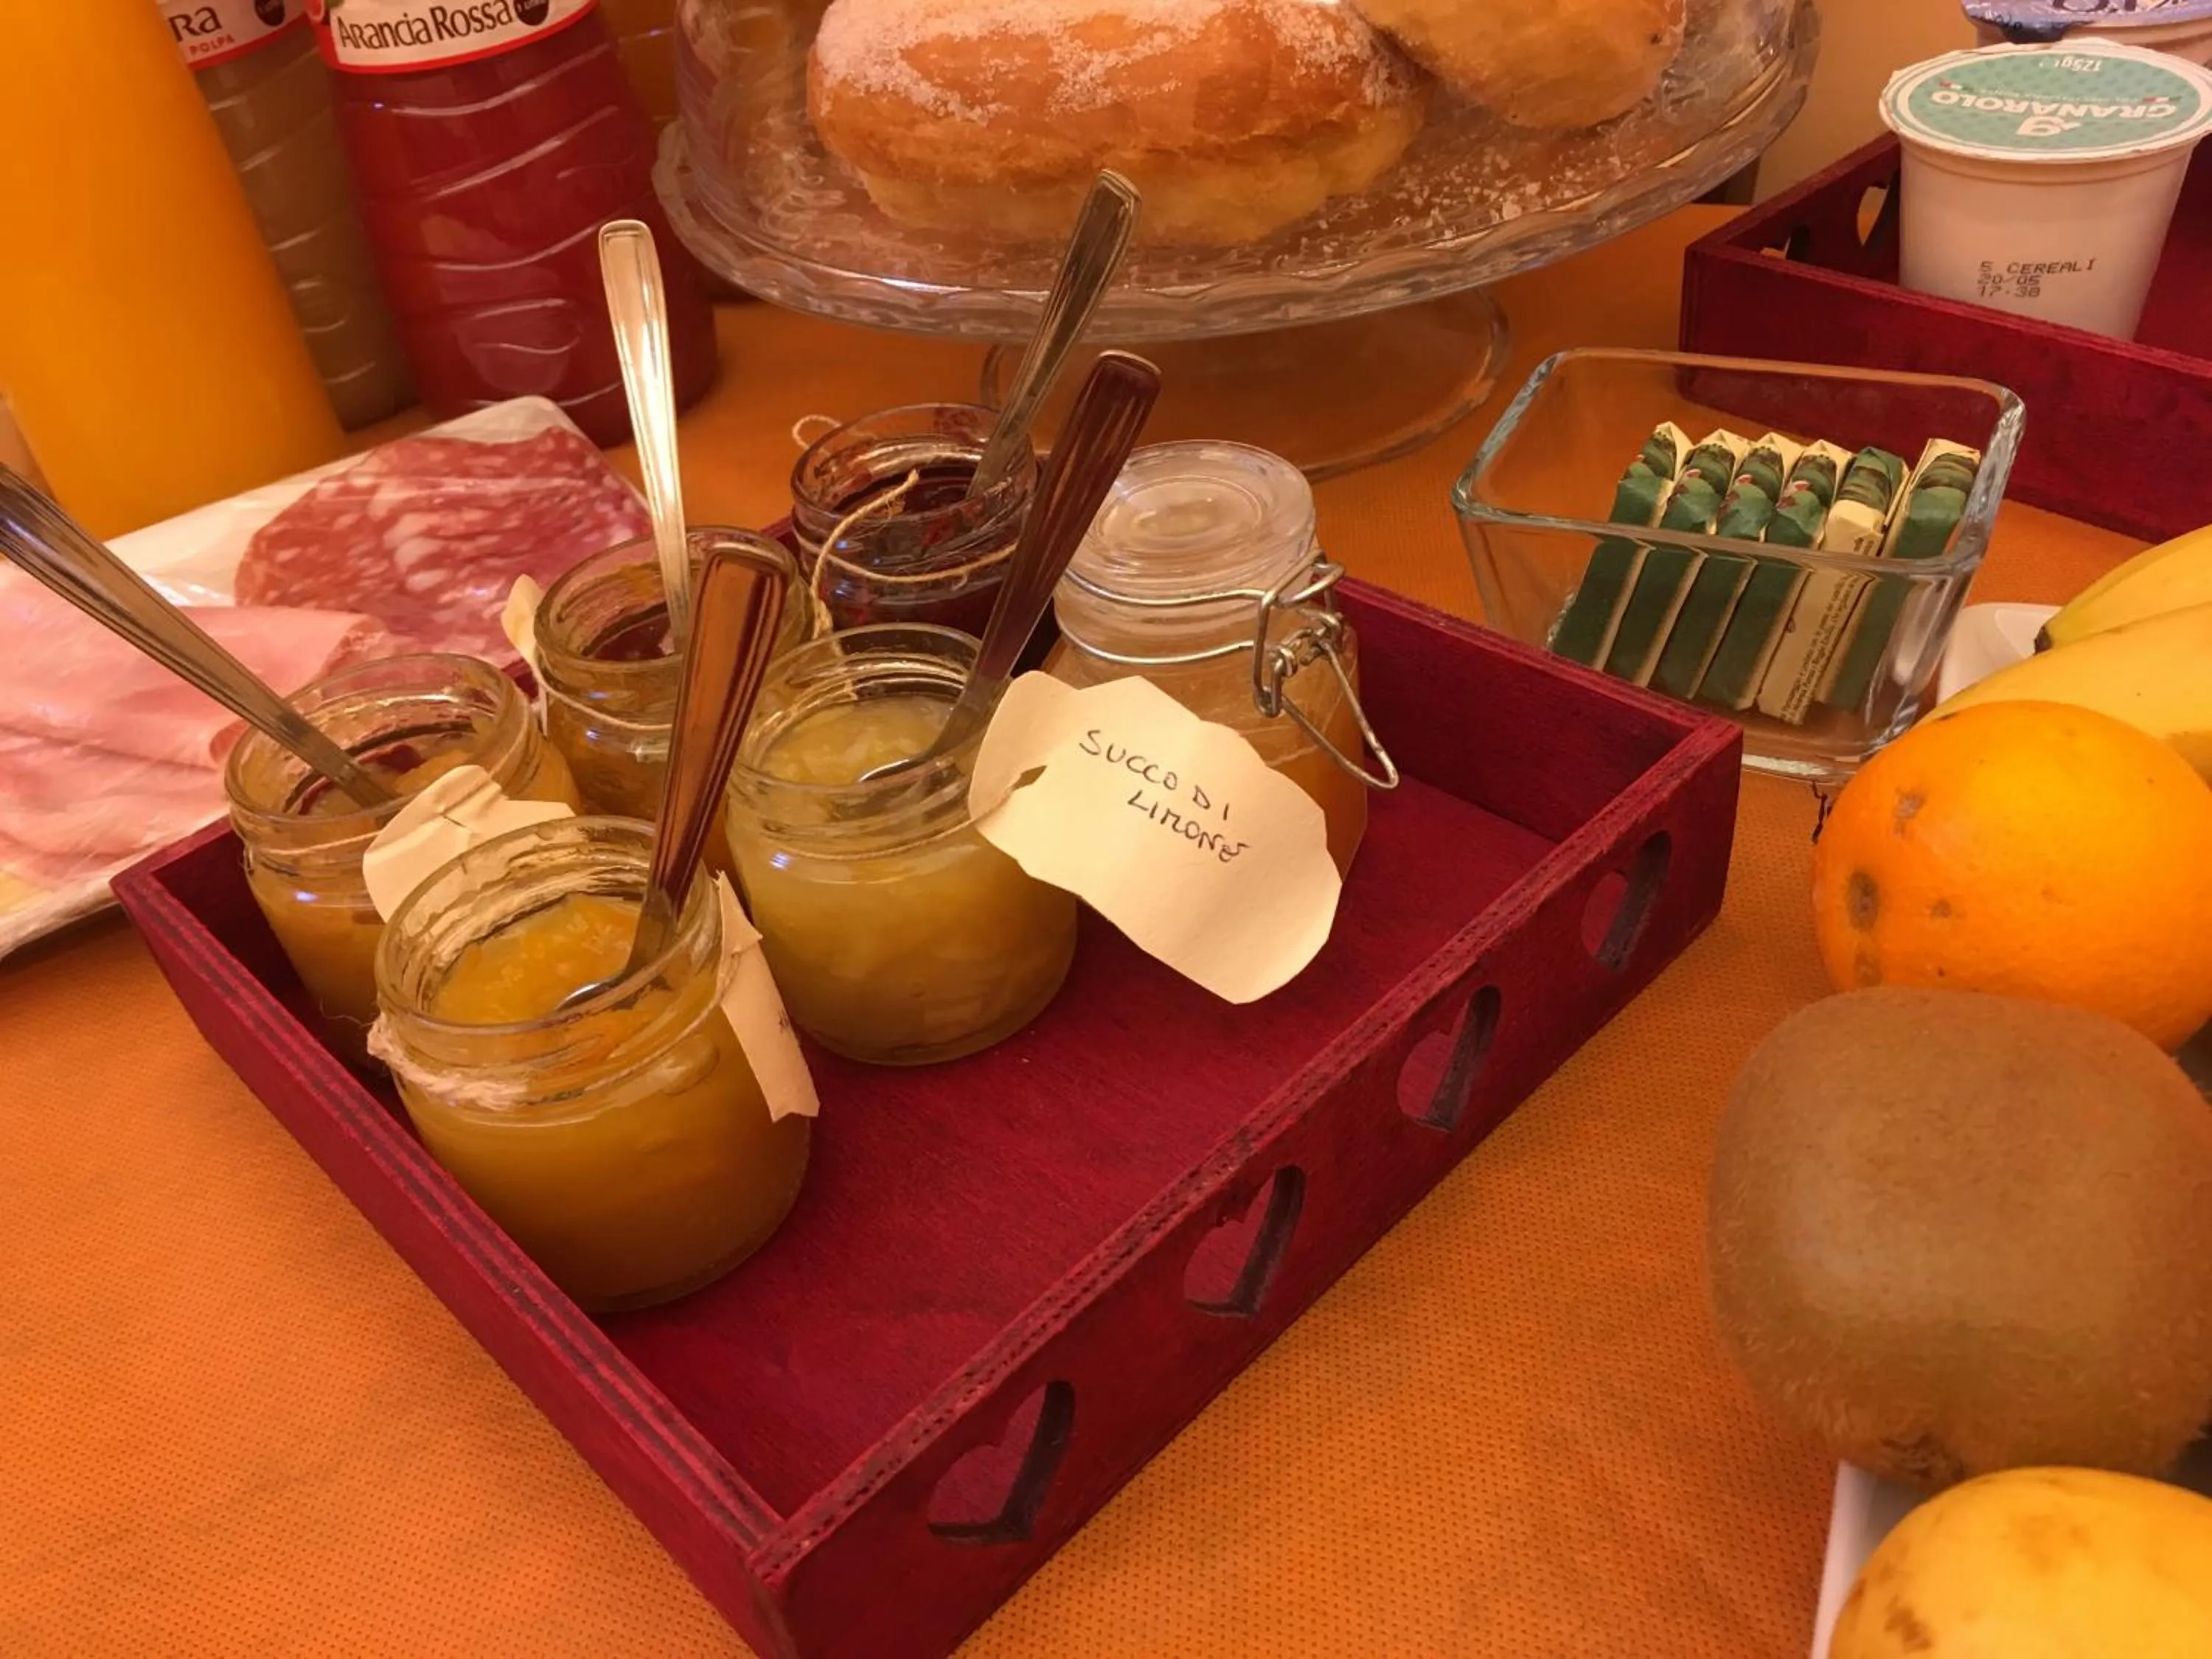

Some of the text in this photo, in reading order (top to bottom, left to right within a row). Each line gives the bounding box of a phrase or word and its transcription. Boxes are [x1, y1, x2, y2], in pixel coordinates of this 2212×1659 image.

[429, 0, 513, 41] Rossa
[189, 33, 235, 55] POLPA
[1930, 90, 2178, 119] GRANAROLO
[2006, 258, 2097, 274] CEREALI
[1079, 729, 1230, 821] SUCCO DI
